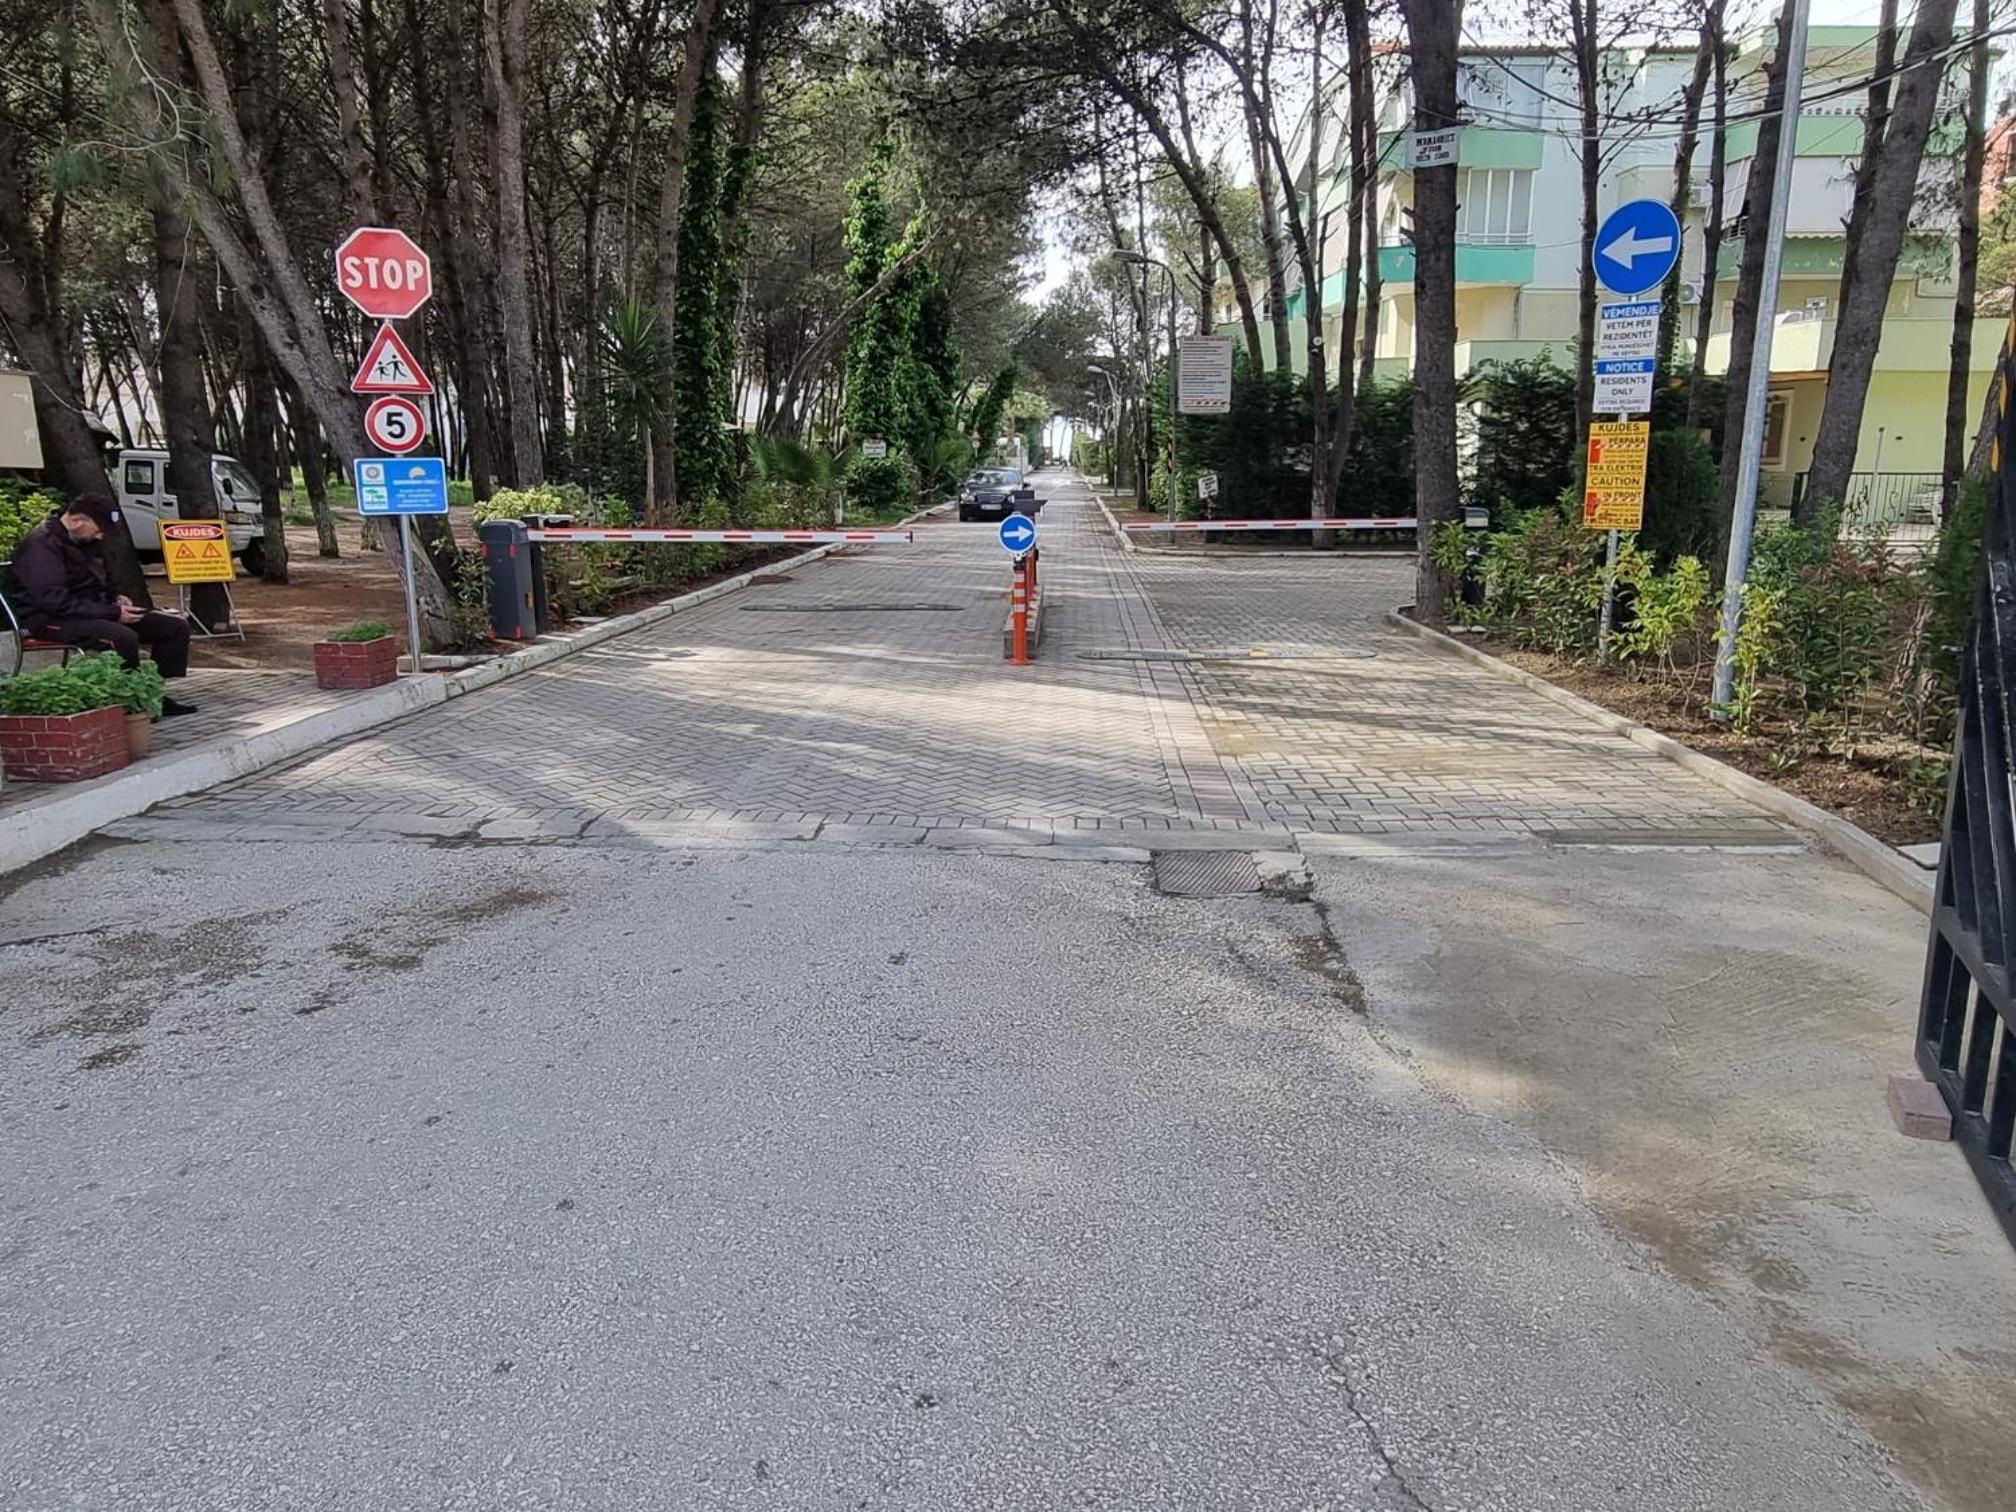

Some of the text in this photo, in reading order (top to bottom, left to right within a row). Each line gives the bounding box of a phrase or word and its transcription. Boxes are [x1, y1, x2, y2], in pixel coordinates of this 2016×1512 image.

[343, 256, 424, 291] STOP
[1605, 362, 1645, 373] NOTICE
[1600, 376, 1647, 385] RESIDENTS
[1612, 387, 1634, 396] ONLY
[386, 412, 406, 439] 5
[1598, 423, 1641, 432] KUJDES
[1591, 477, 1640, 486] CAUTION
[172, 527, 215, 538] KUJDES
